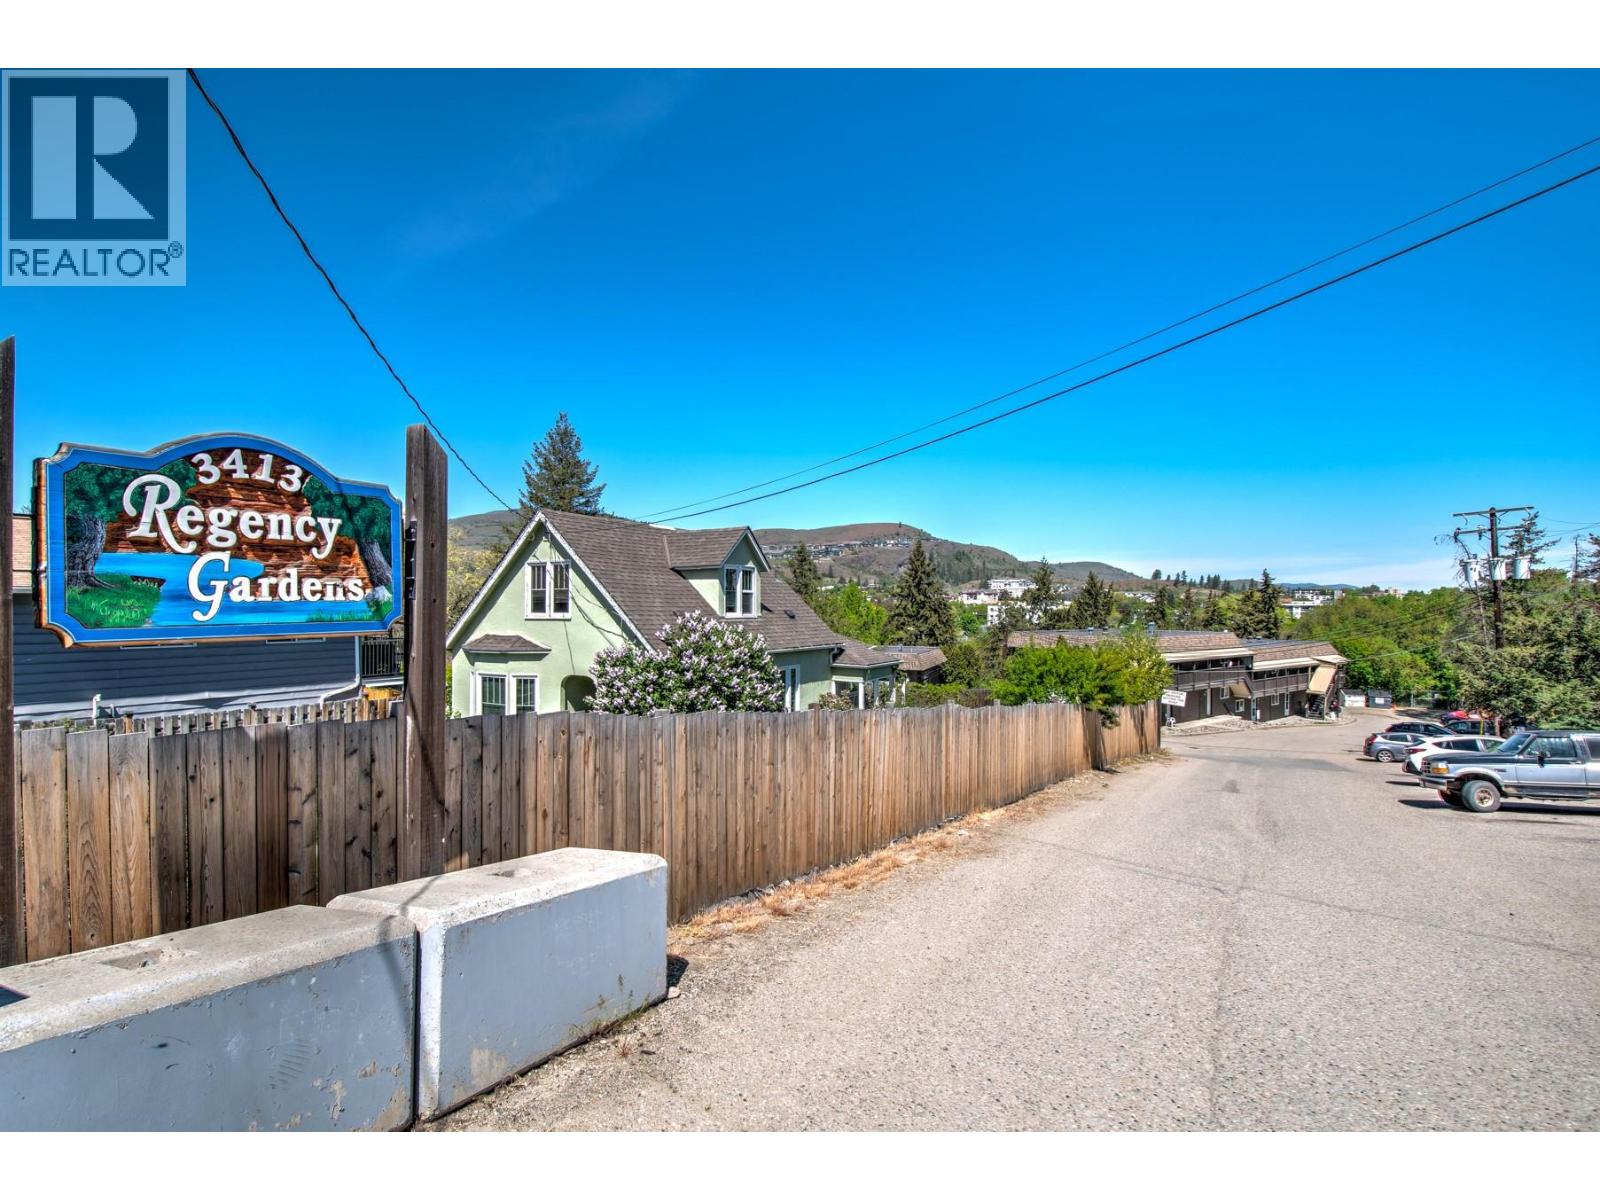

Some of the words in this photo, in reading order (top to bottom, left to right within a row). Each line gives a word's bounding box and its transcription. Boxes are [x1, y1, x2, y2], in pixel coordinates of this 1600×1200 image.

[191, 448, 304, 493] 3413
[123, 473, 343, 560] Regency
[187, 550, 366, 622] Gardens
